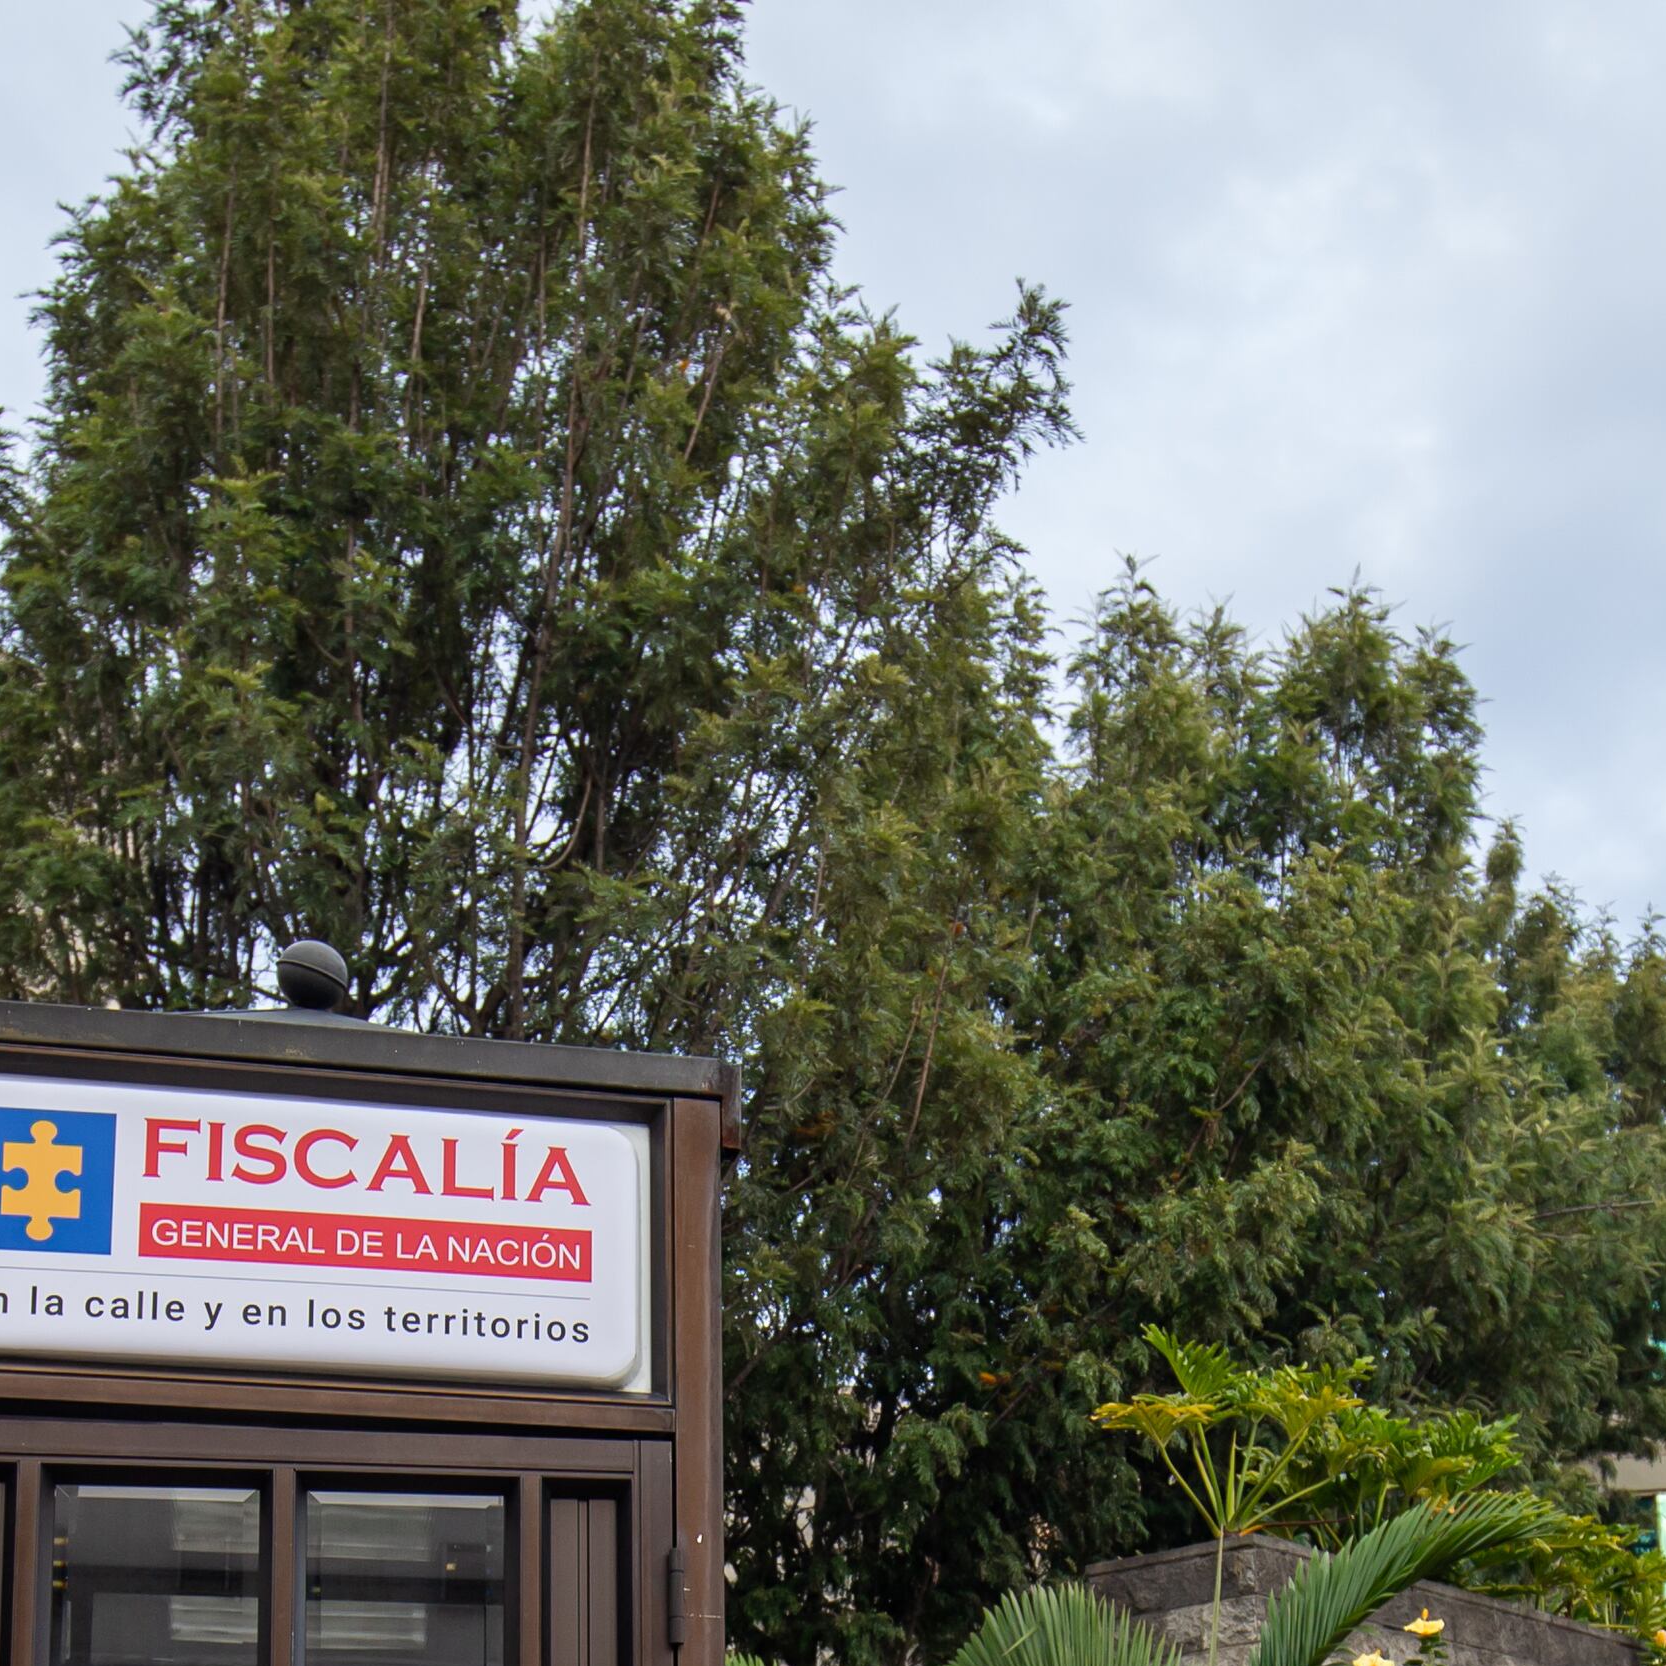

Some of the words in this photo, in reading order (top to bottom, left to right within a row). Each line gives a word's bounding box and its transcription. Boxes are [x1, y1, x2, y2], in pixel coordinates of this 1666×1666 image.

[142, 1117, 591, 1206] FISCALÍA
[151, 1219, 325, 1254] GENERAL
[336, 1229, 383, 1257] DE
[396, 1233, 438, 1261] LA
[448, 1233, 581, 1270] NACIÓN
[31, 1286, 64, 1316] la
[85, 1291, 184, 1321] calle
[204, 1302, 223, 1330] y
[242, 1303, 287, 1326] en
[308, 1299, 366, 1330] los
[384, 1306, 589, 1343] territorios
